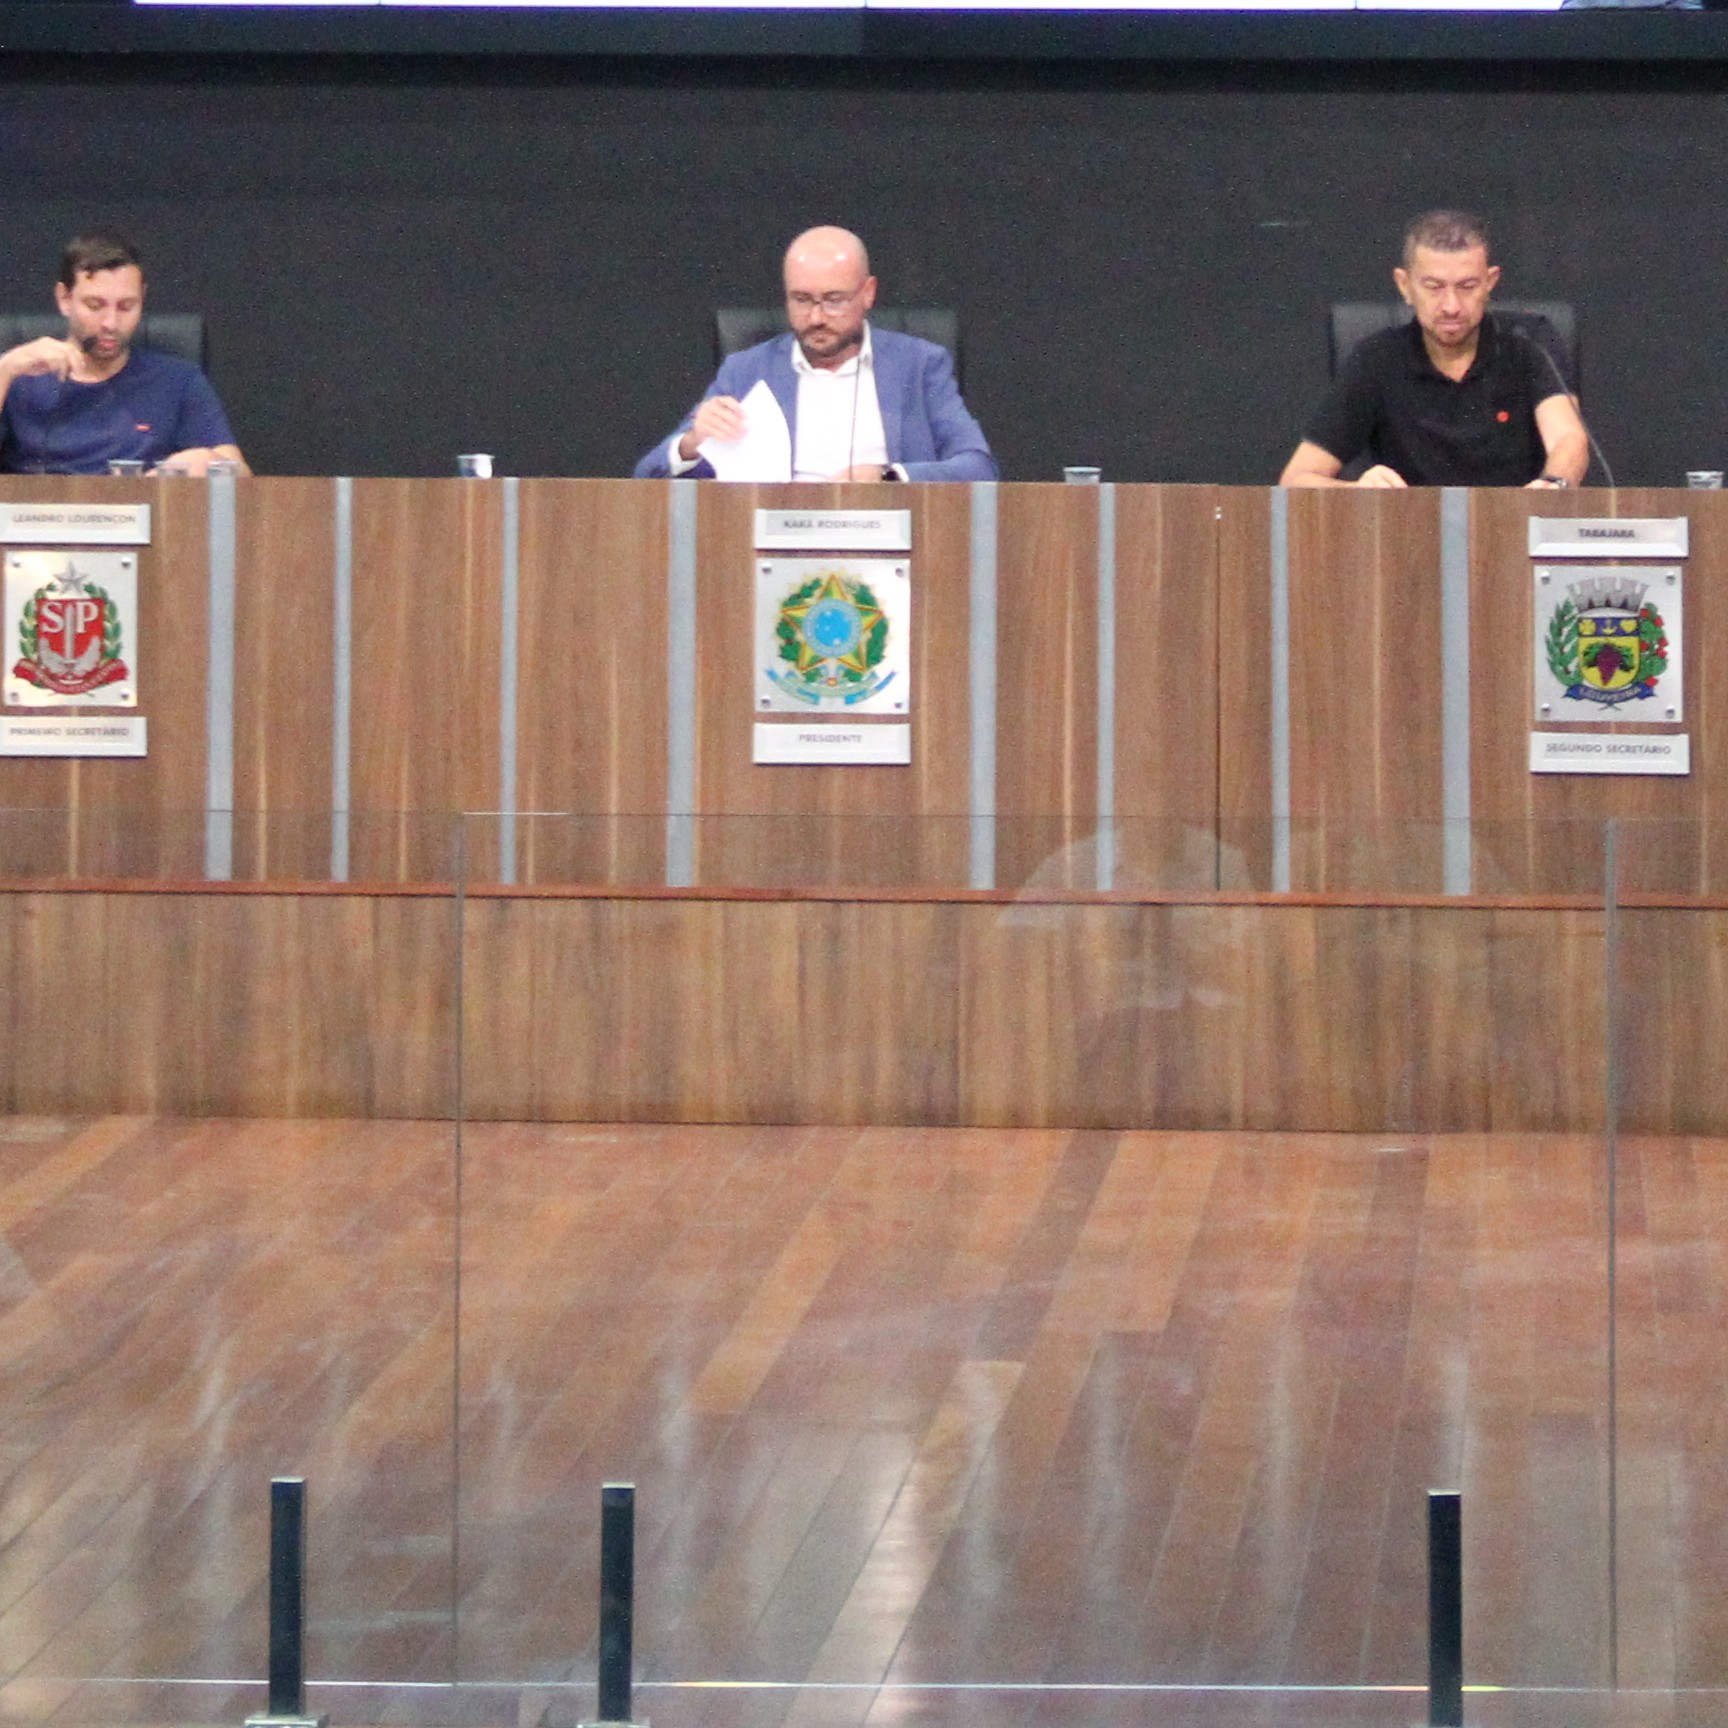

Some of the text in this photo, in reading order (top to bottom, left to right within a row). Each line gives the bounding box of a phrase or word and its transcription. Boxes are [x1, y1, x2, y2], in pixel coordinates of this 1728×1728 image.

[12, 513, 65, 524] LEANDRO
[817, 519, 883, 530] RODRIGUES
[1578, 527, 1636, 539] TABAJARA
[798, 733, 863, 744] PRESIDENTE
[1545, 742, 1603, 754] SEGUNDO
